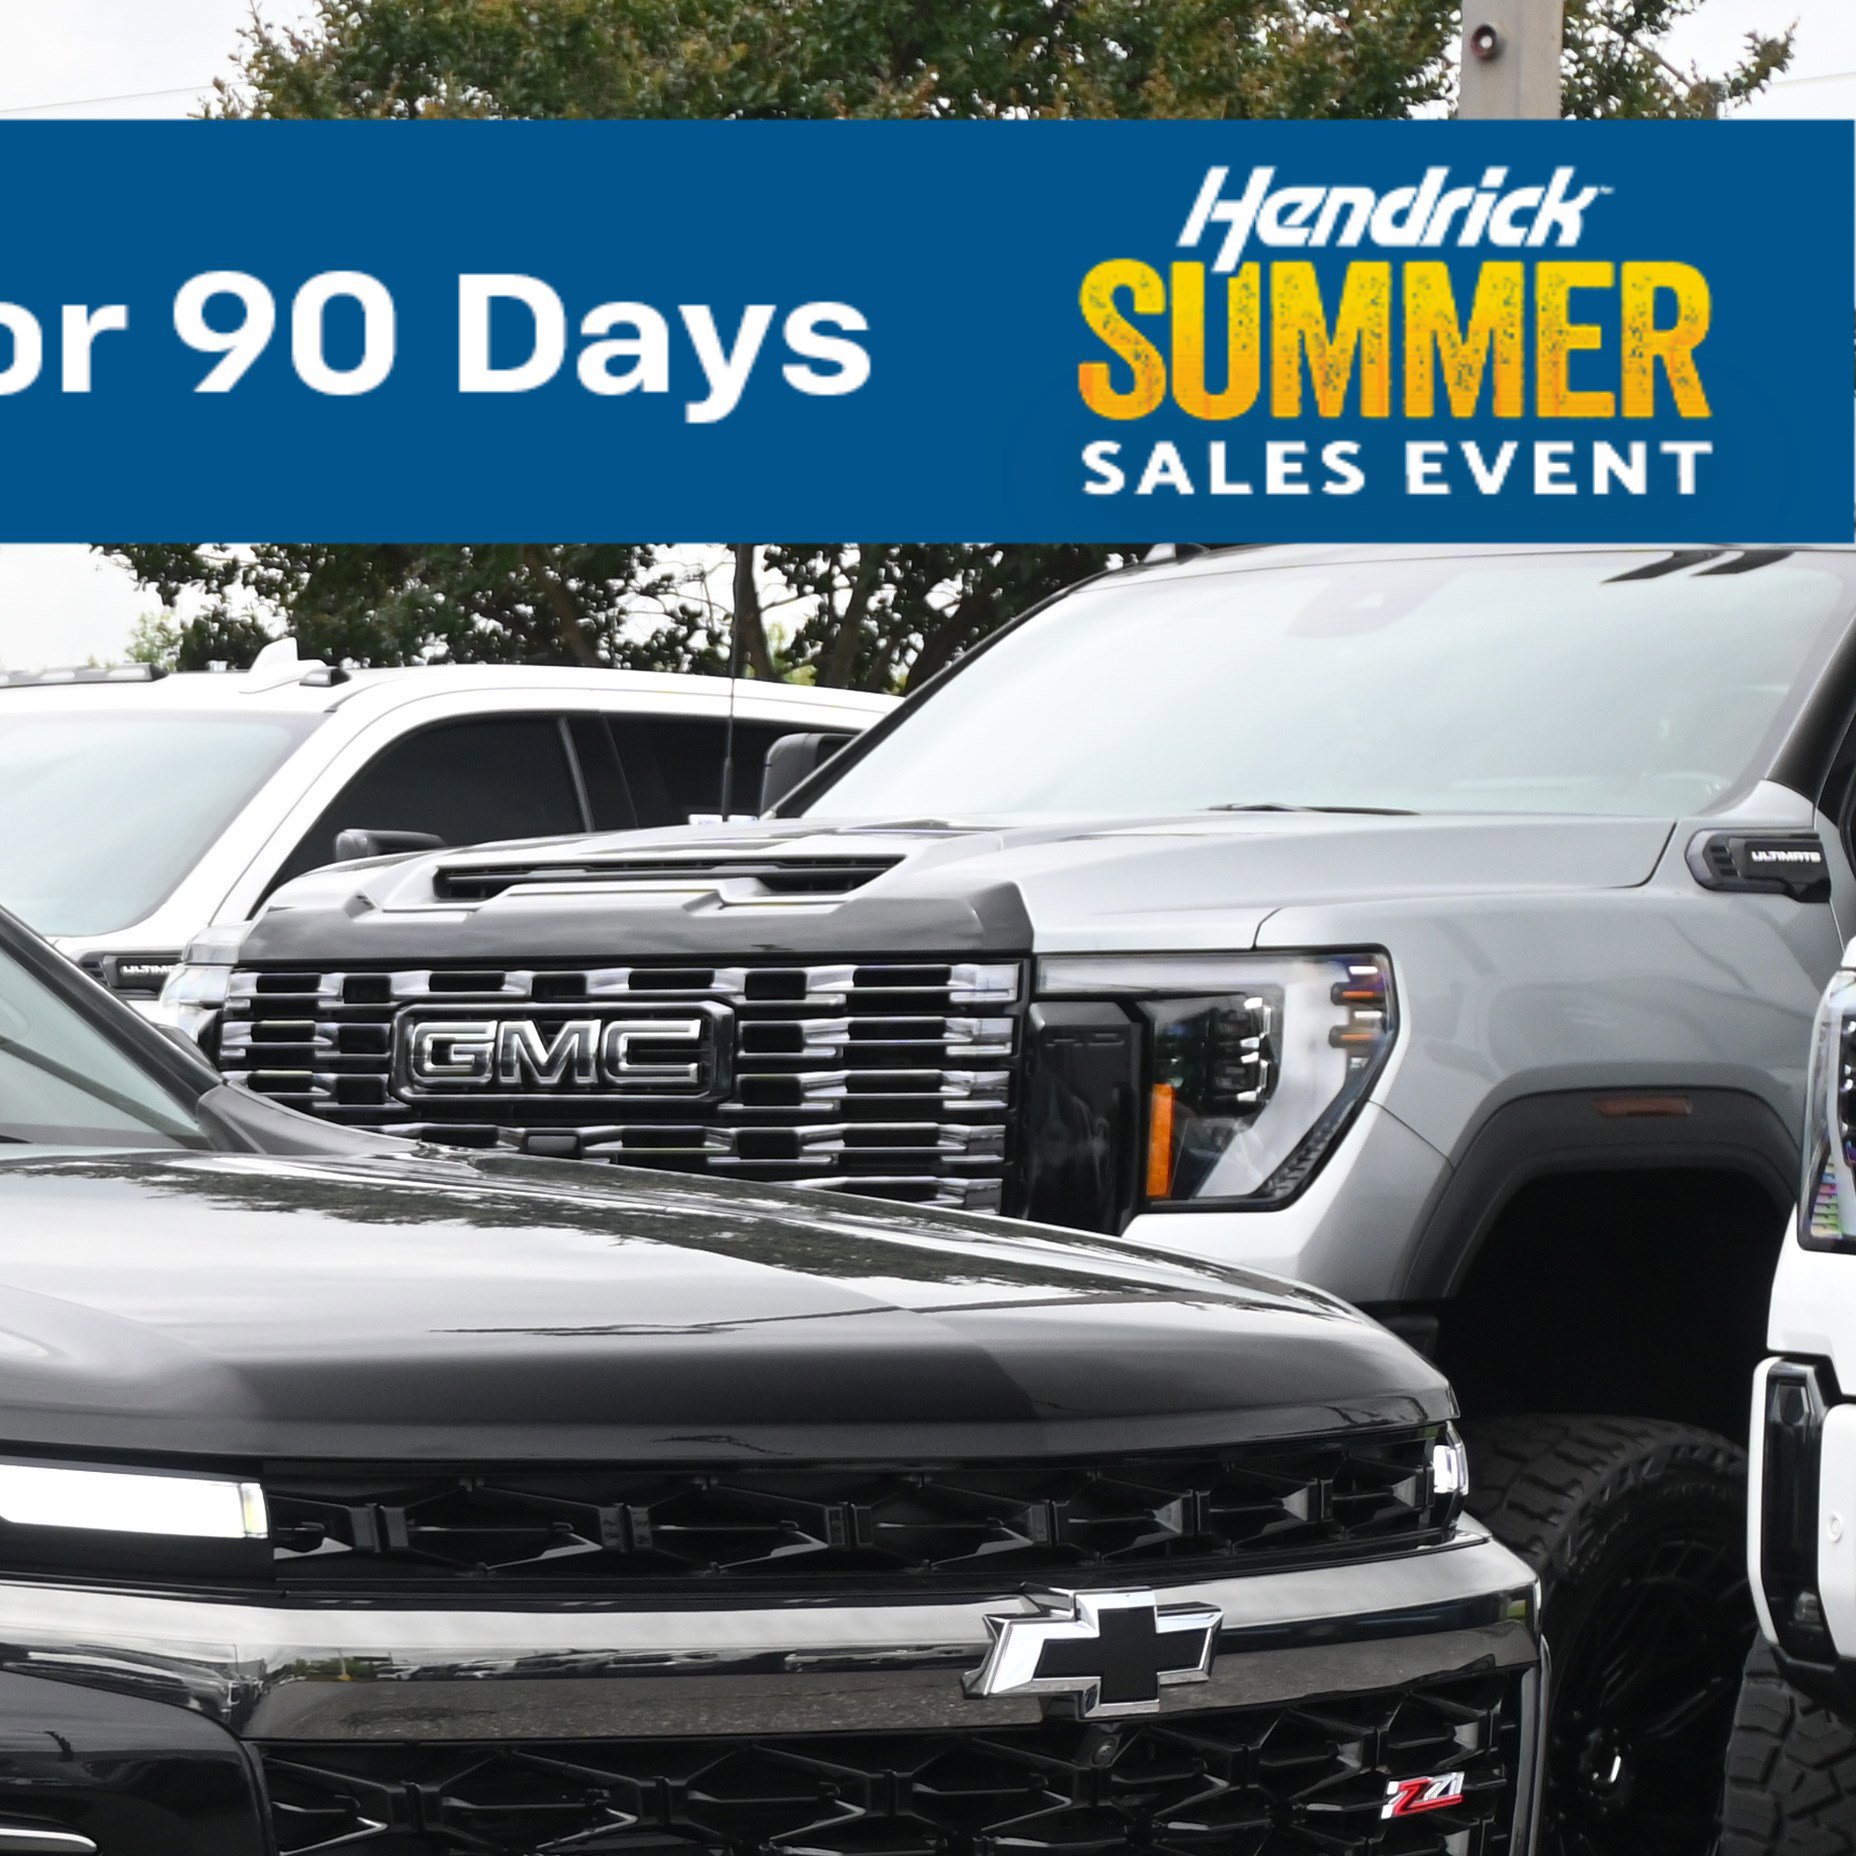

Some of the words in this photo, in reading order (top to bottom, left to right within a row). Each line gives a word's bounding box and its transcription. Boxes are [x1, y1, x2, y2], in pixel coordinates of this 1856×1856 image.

[1751, 850, 1822, 863] ULTIMATE
[411, 1017, 701, 1087] GMC
[1382, 1771, 1465, 1819] Z71
